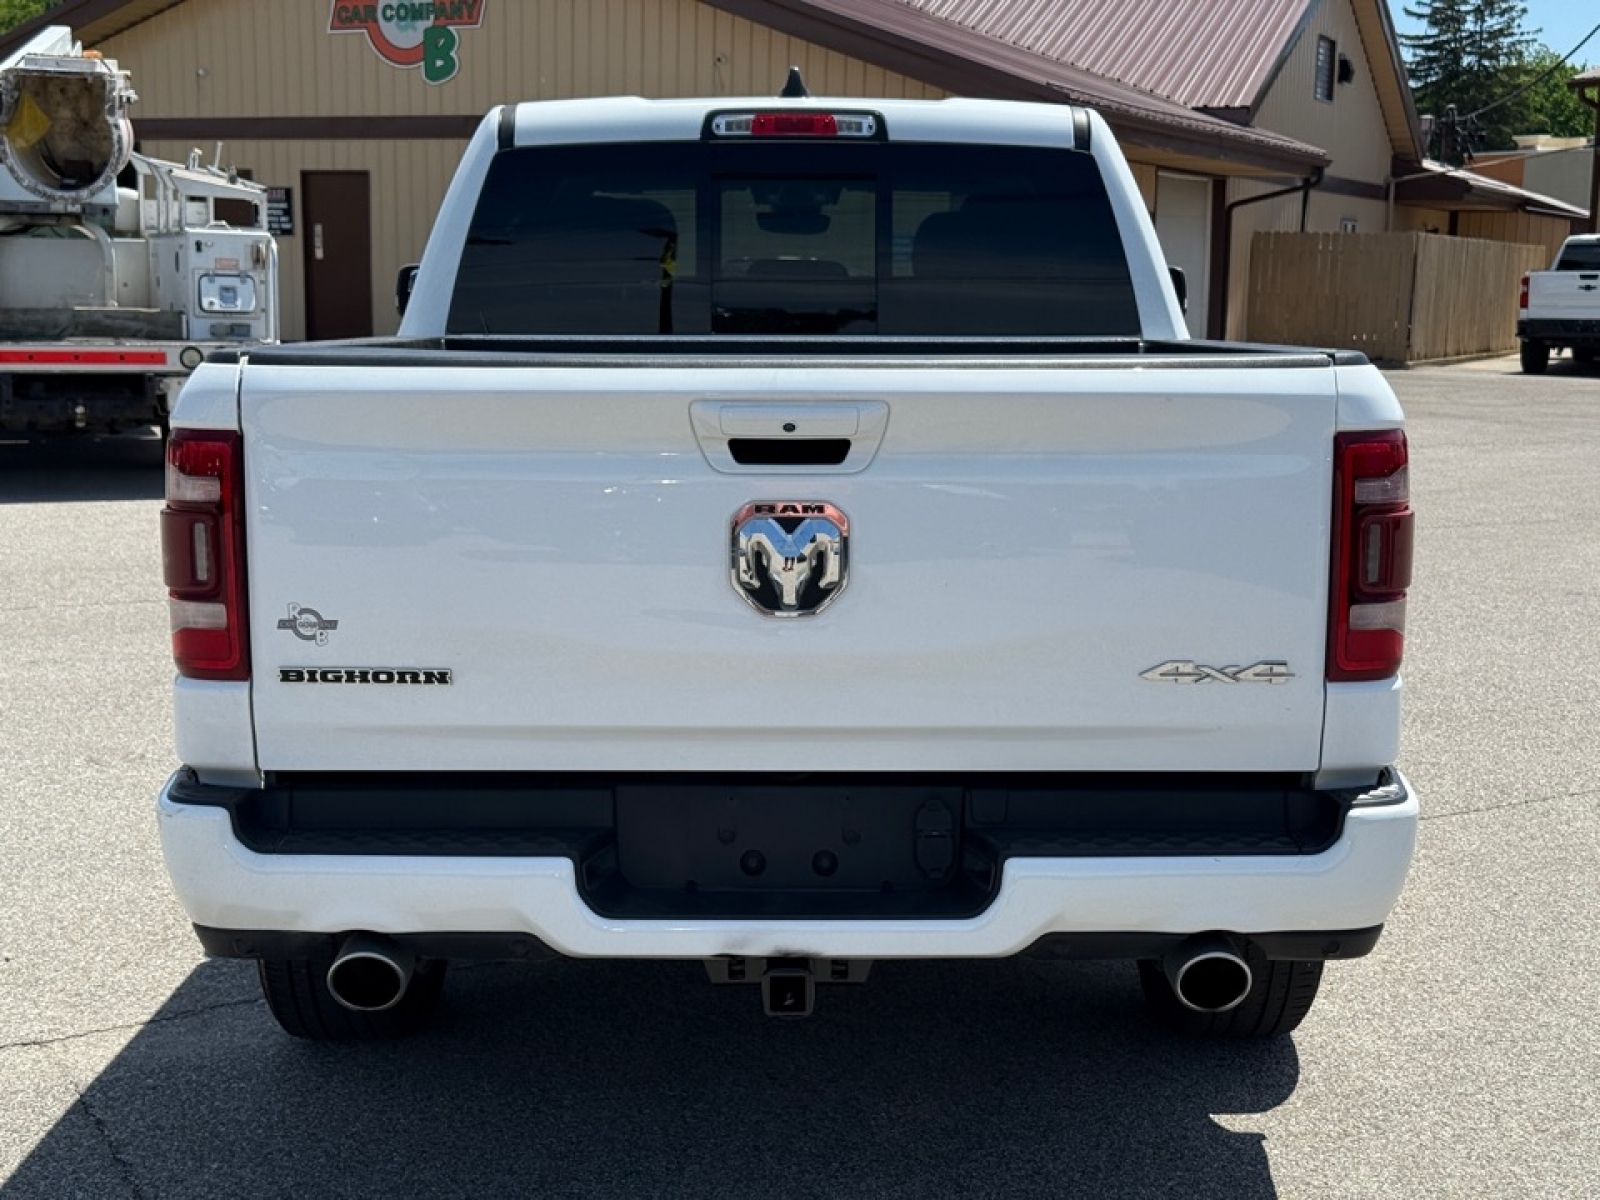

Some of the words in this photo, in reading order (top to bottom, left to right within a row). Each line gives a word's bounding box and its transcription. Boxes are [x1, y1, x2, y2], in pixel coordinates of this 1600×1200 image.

[336, 5, 378, 24] CAR
[381, 0, 477, 22] COMPANY
[423, 26, 458, 82] B
[754, 504, 824, 514] RAM
[315, 630, 329, 646] B
[279, 668, 451, 685] BIGHORN
